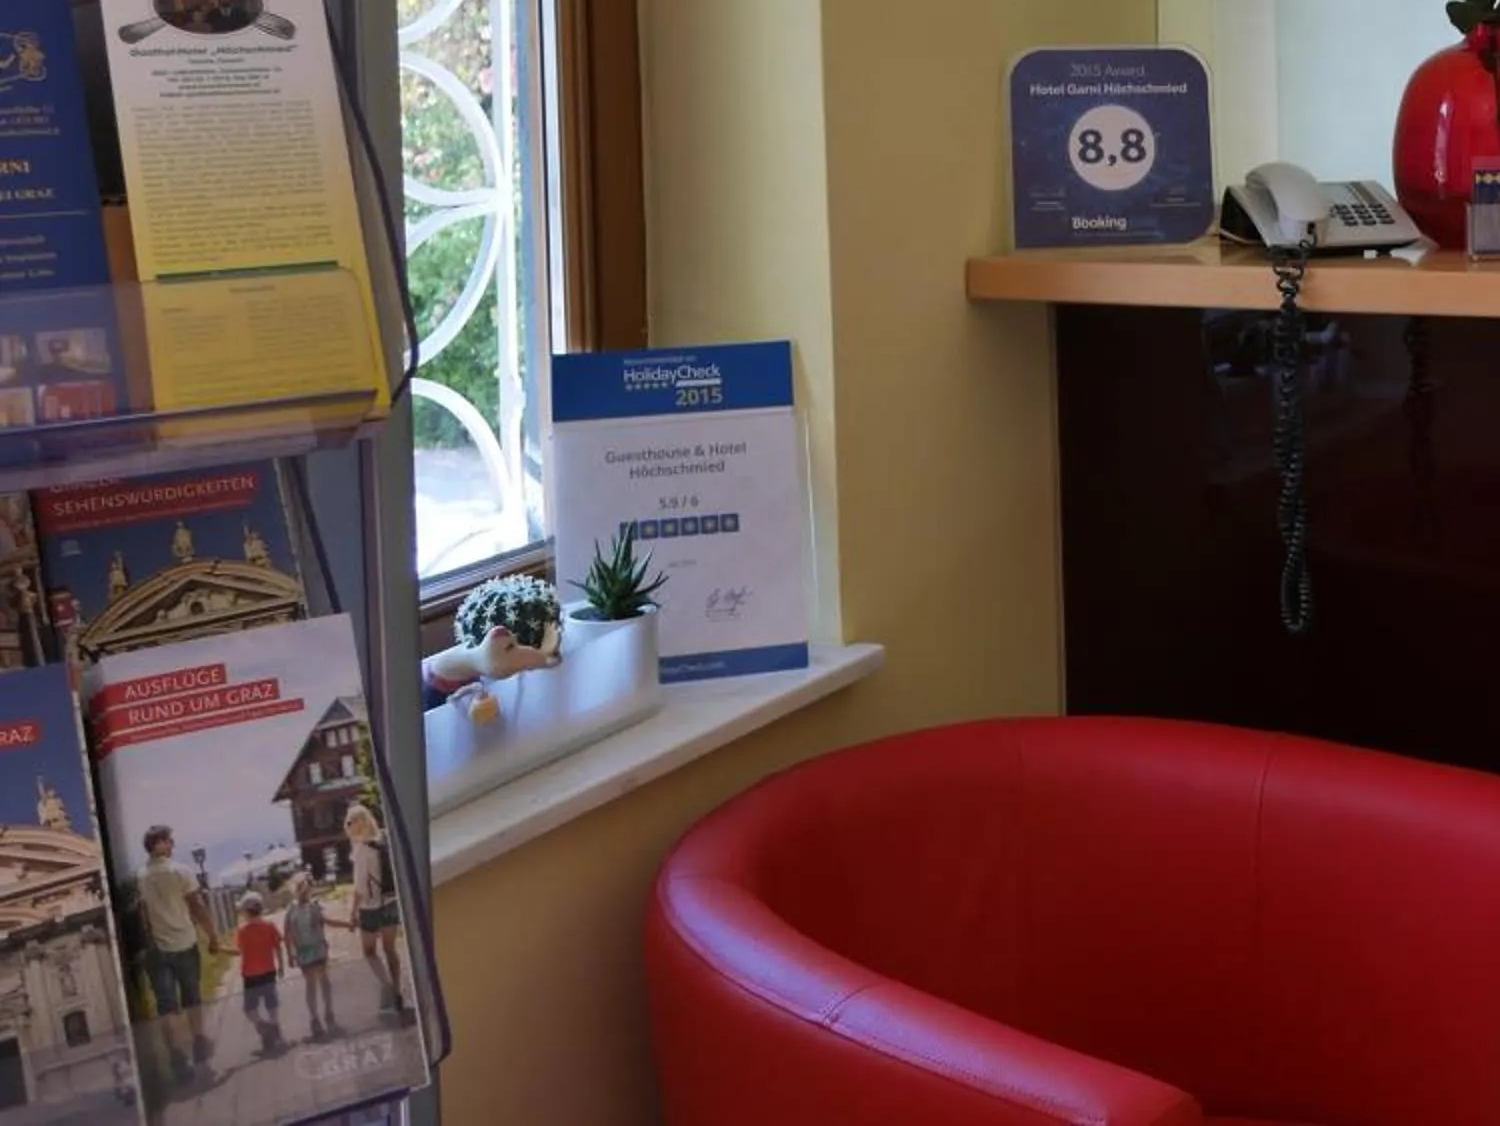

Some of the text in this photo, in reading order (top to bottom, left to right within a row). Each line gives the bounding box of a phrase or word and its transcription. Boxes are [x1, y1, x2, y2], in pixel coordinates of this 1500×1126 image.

[1070, 63, 1145, 78] 2015 Award
[1029, 83, 1065, 97] Hotel
[1067, 83, 1100, 96] Garni
[1077, 128, 1147, 167] 8,8
[624, 361, 722, 383] HolidayCheck
[675, 387, 724, 407] 2015
[605, 441, 747, 465] Guesthouse & Hotel
[128, 701, 184, 726] RUND
[189, 695, 221, 716] UM
[226, 682, 275, 706] GRAZ
